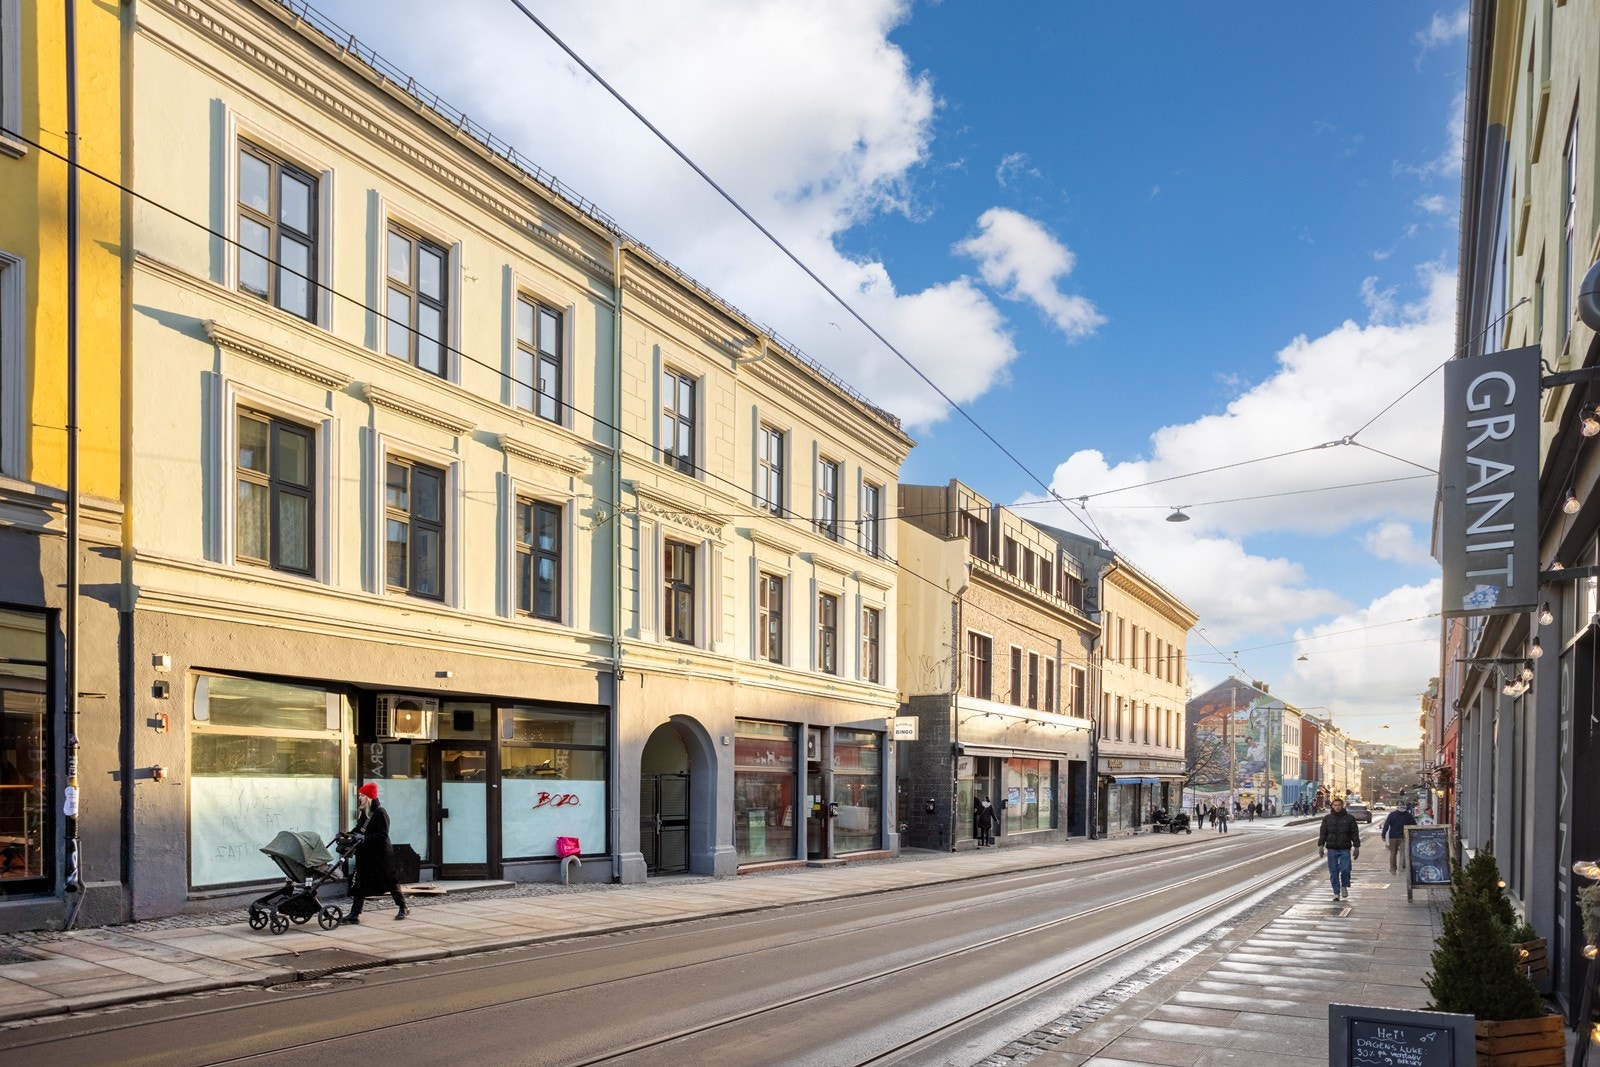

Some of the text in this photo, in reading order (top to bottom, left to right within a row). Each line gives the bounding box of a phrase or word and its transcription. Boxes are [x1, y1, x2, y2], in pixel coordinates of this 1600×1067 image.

[1466, 371, 1516, 588] GRANIT
[532, 791, 579, 809] BOZO
[1558, 662, 1569, 948] GRANIT
[1377, 1027, 1404, 1040] Hei!
[1357, 1039, 1397, 1051] DAGENS
[1356, 1048, 1376, 1058] 30%
[1384, 1057, 1393, 1066] og
